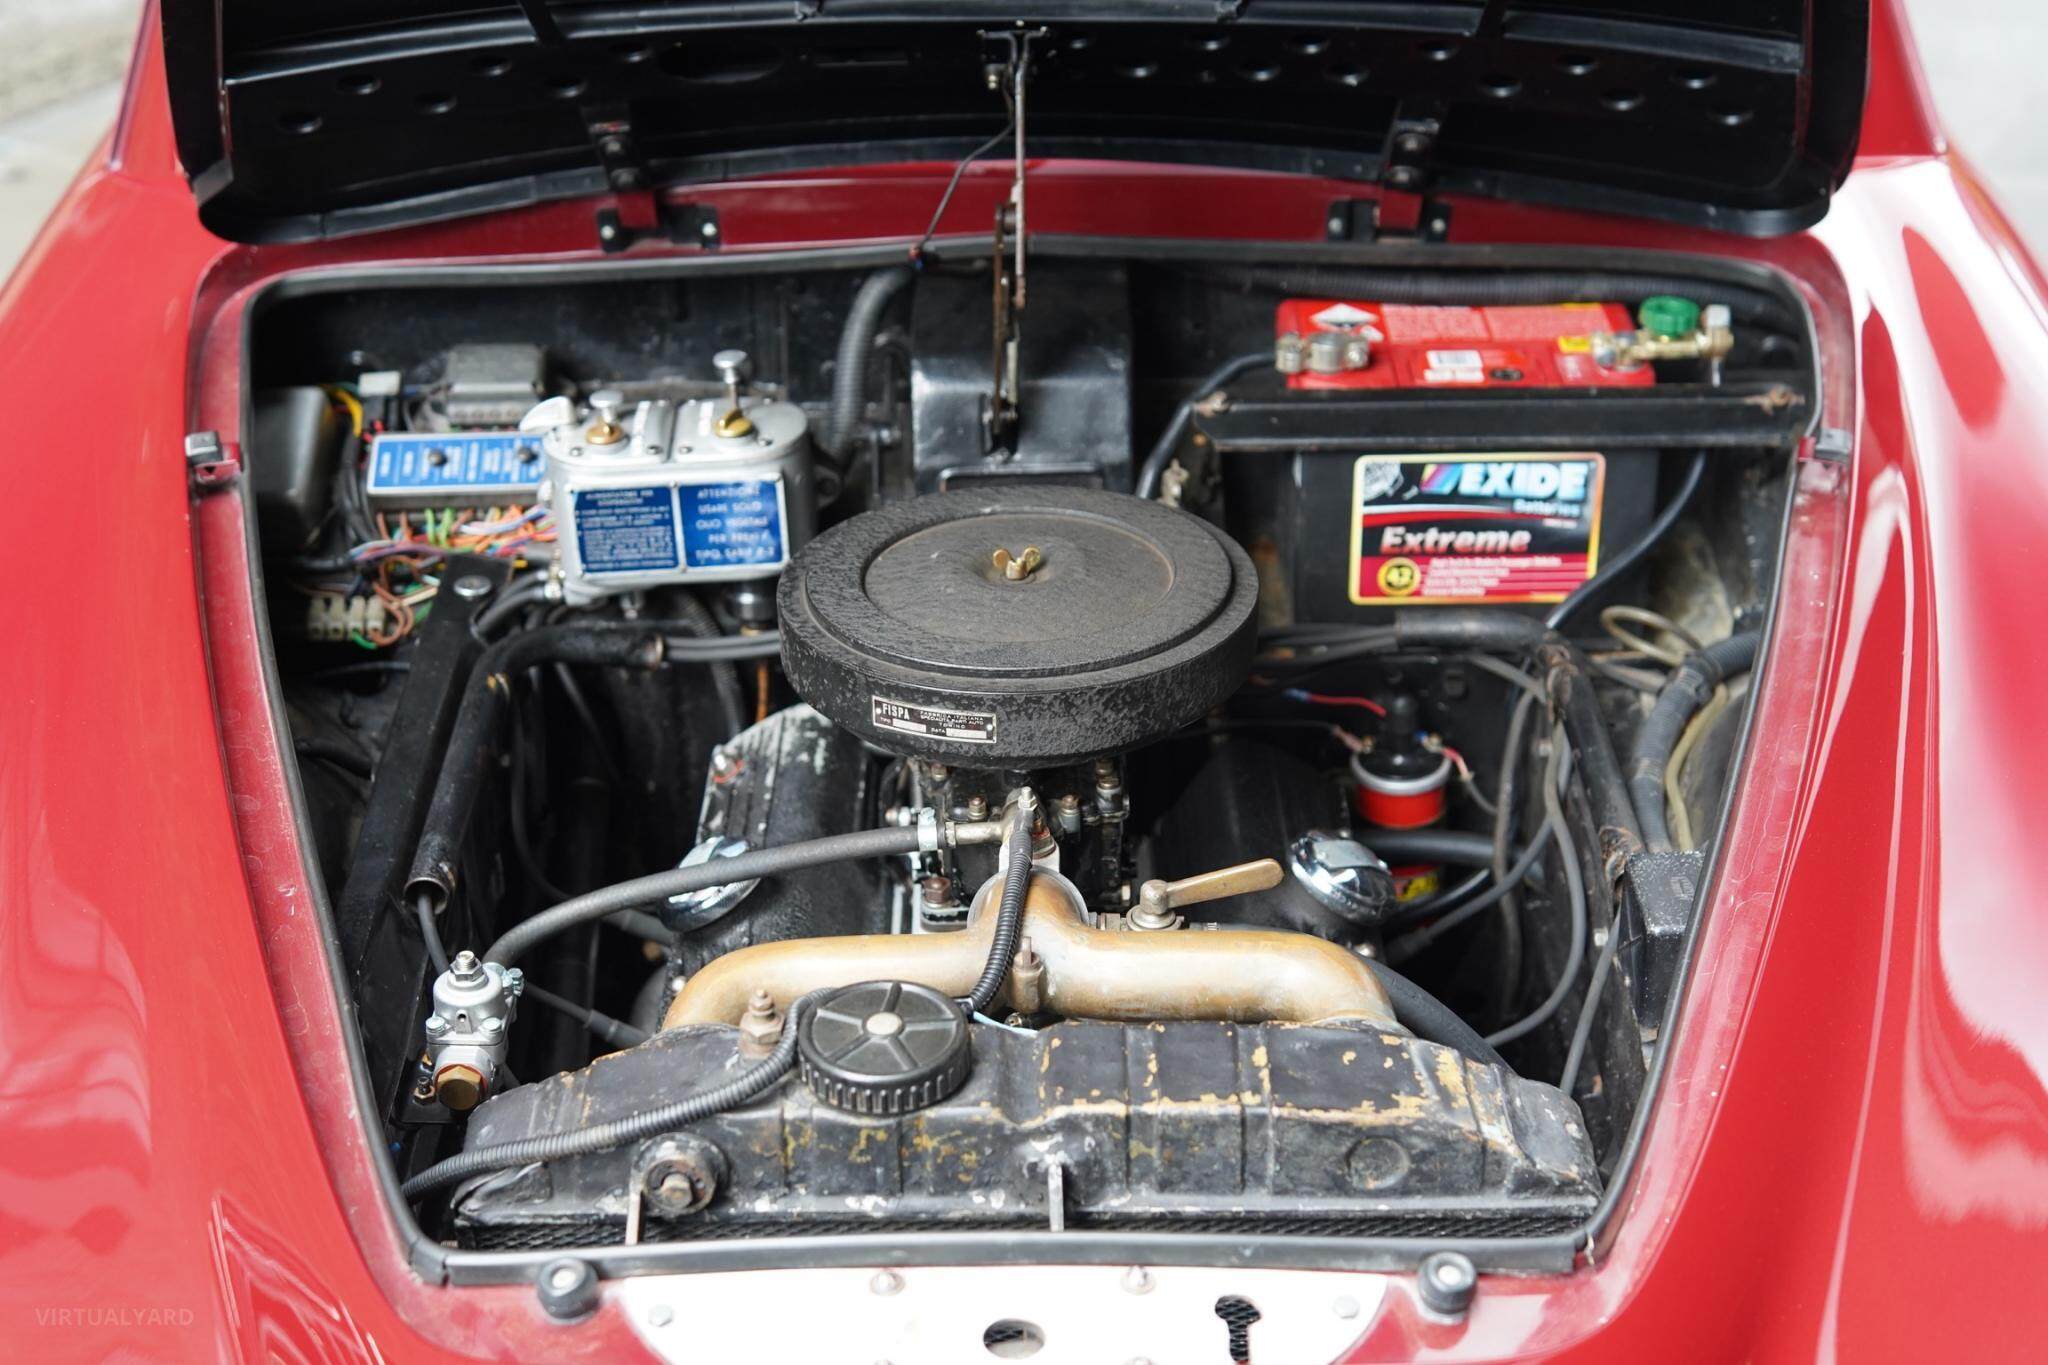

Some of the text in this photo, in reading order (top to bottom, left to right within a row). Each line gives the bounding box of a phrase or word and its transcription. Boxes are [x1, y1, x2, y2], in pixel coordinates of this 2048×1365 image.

[1458, 462, 1588, 500] EXIDE
[698, 501, 762, 514] USARE SOLO
[1513, 498, 1581, 517] Batteries
[695, 519, 721, 530] OLIO
[1380, 525, 1532, 555] Extreme
[882, 703, 910, 720] FISPA
